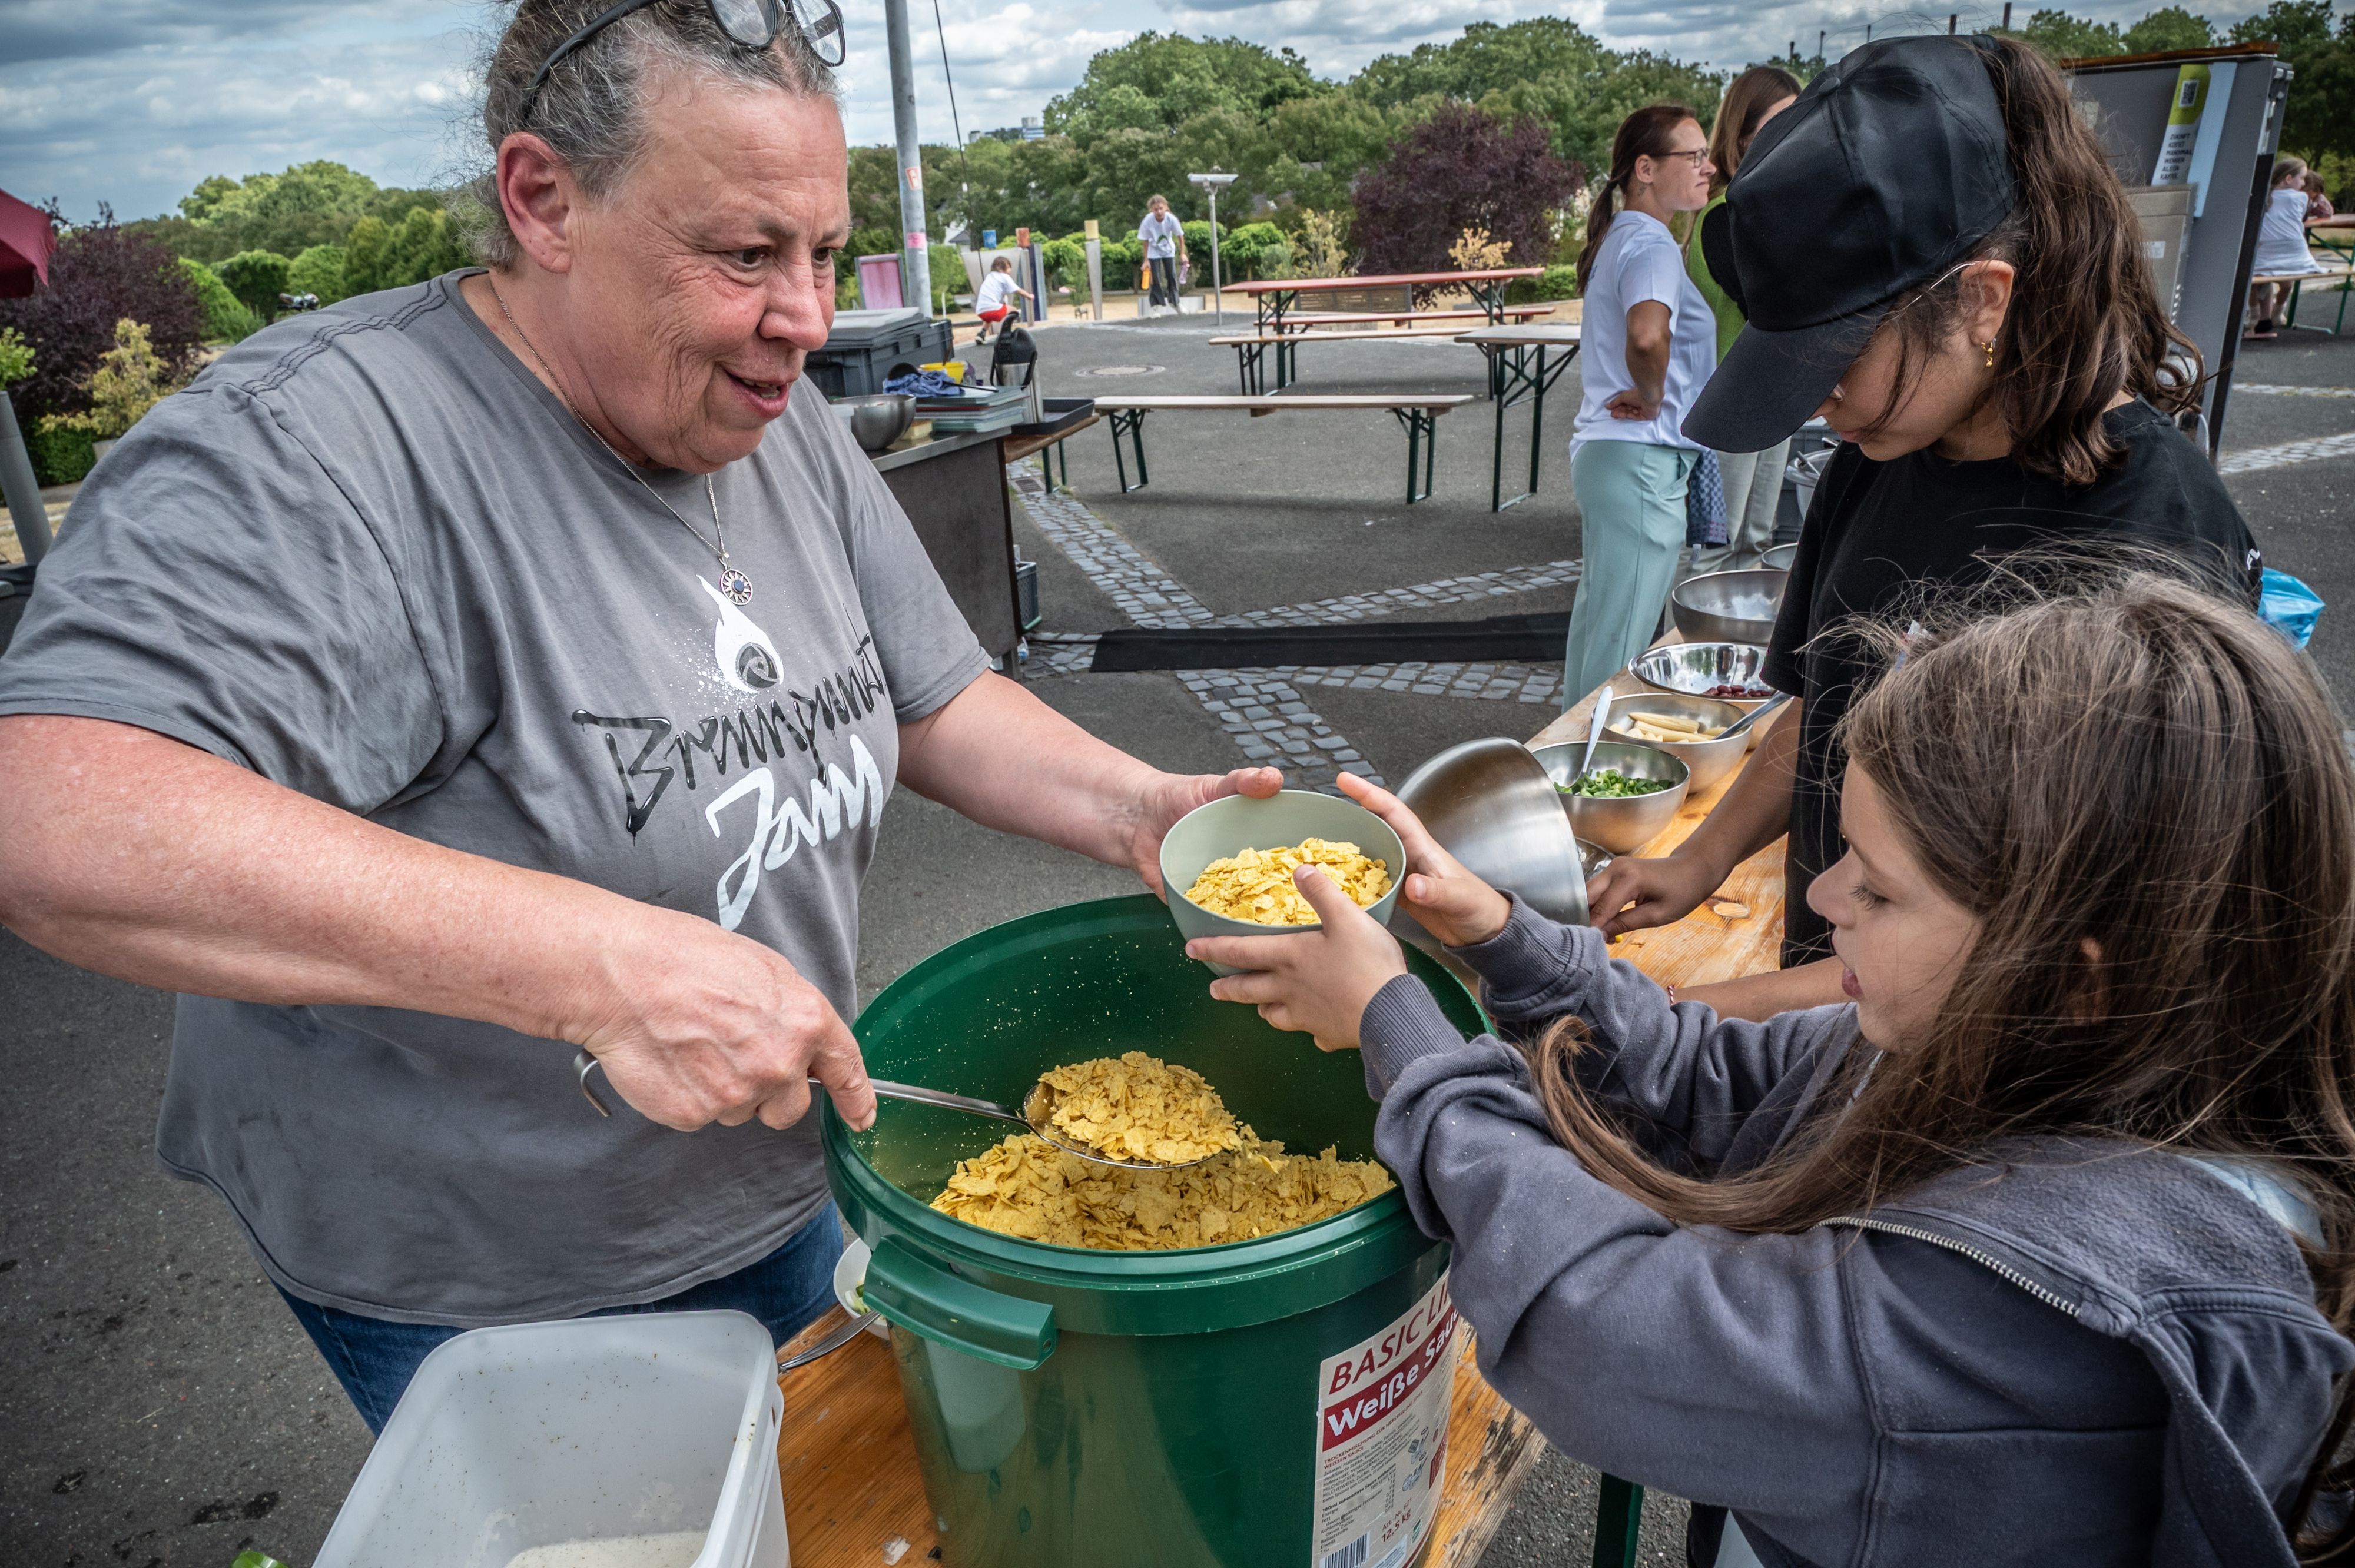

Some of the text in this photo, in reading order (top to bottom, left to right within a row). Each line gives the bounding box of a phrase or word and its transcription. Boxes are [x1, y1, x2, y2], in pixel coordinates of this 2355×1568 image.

[706, 733, 884, 931] Jam
[1329, 1308, 1424, 1395] BASIC
[1328, 1364, 1419, 1437] Weiße
[1324, 1433, 1375, 1464] TROCKENMISCHUNG
[1376, 1426, 1385, 1434] ZUR
[1386, 1403, 1412, 1427] HERSTELLUNG
[1324, 1446, 1363, 1469] WEISSEN SAUCE
[1322, 1461, 1396, 1512] 100ml zubereitete Sauce enthalten
[1322, 1507, 1338, 1519] Energie
[1381, 1520, 1399, 1542] 12,5
[1402, 1508, 1410, 1523] kg
